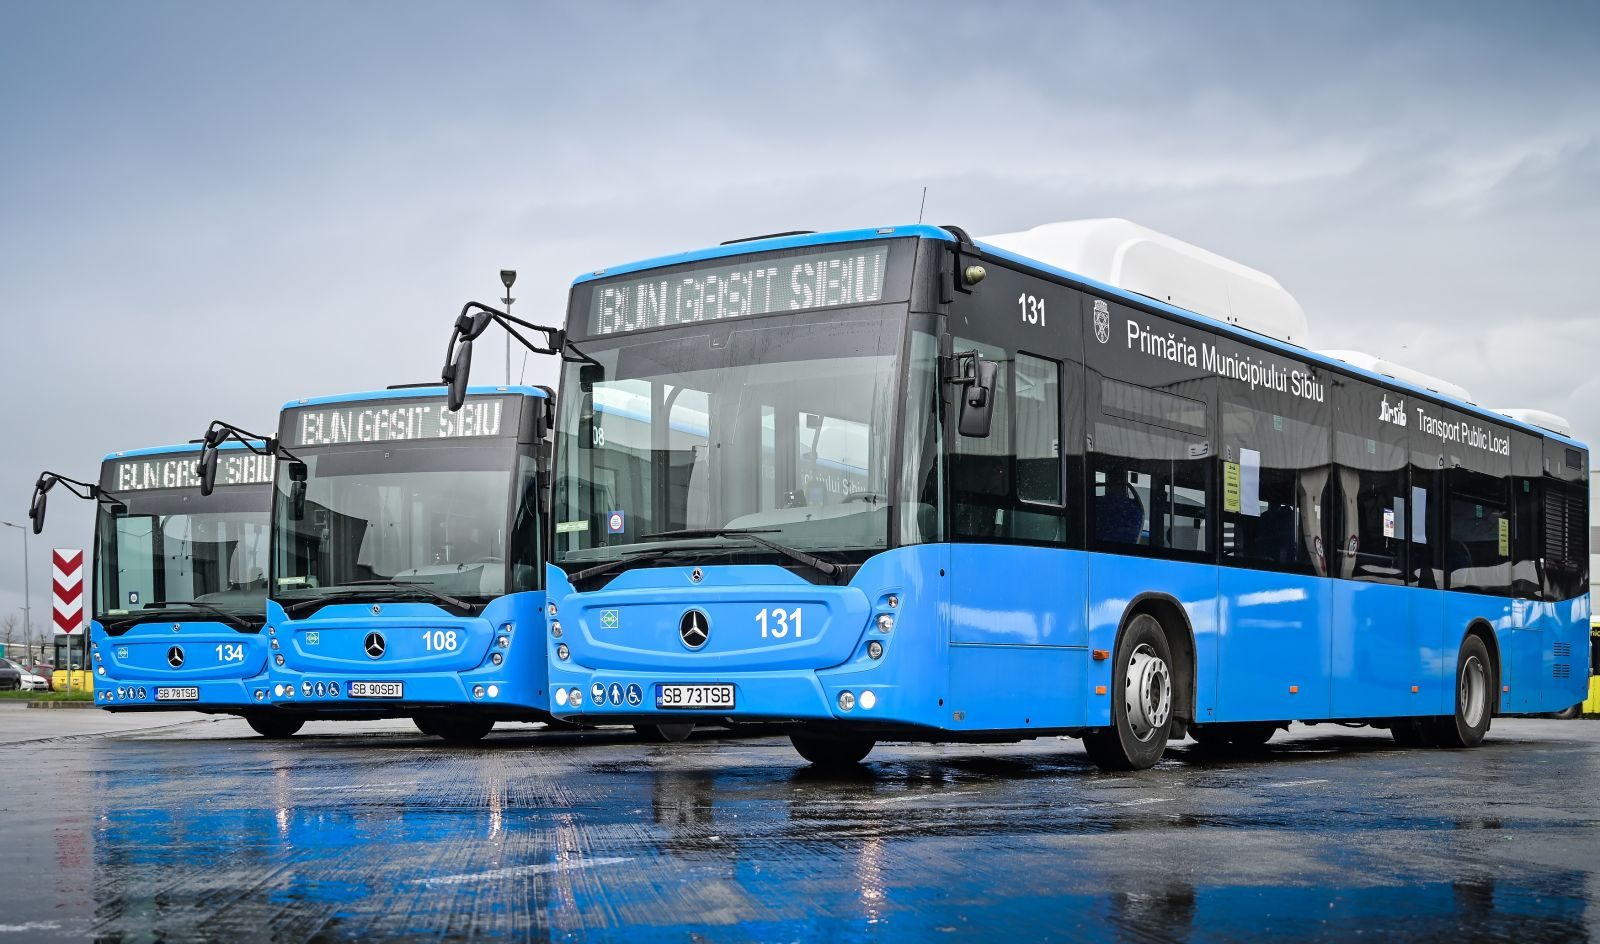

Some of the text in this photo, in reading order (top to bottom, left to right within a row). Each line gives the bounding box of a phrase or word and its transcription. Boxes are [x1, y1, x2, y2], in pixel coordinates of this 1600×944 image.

[598, 254, 881, 336] BUN GASIT SIBIU
[1018, 293, 1046, 327] 131
[1127, 319, 1324, 403] Primăria Municipiului Sibiu
[301, 401, 500, 445] BUN GASIT SIBIU
[592, 425, 604, 446] 08
[1417, 408, 1509, 456] Transport Public Local
[119, 462, 160, 491] BUN
[755, 607, 803, 638] 131
[215, 644, 244, 662] 134
[422, 630, 457, 651] 108
[158, 688, 169, 698] SB
[353, 683, 366, 695] SB
[369, 684, 400, 695] 90SBT
[663, 687, 682, 704] SB
[686, 686, 731, 704] 73TSB
